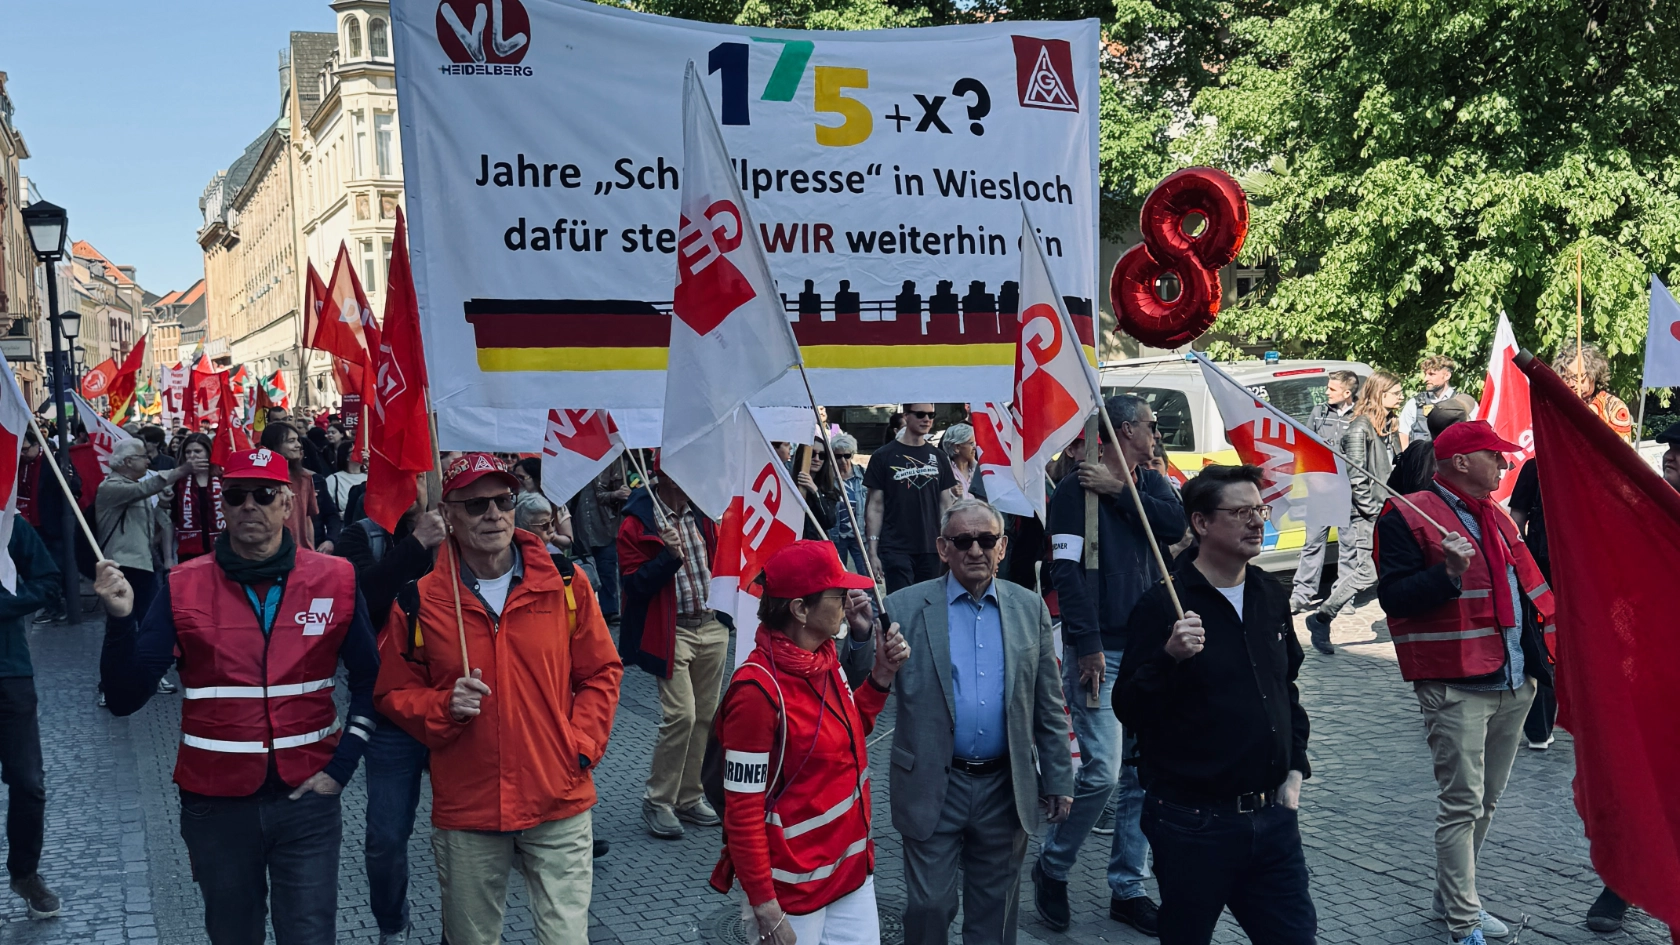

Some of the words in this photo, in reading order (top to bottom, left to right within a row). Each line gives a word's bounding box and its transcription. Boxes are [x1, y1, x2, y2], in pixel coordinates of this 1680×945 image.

[440, 64, 533, 77] HEIDELBERG
[707, 36, 873, 147] 175
[475, 153, 582, 188] Jahre
[593, 156, 882, 199] „Schlpresse“
[893, 165, 925, 197] in
[932, 167, 1074, 205] Wiesloch
[503, 217, 609, 252] dafür
[759, 222, 835, 254] WIR
[845, 223, 1007, 256] weiterhin
[248, 452, 273, 463] GEW
[294, 611, 334, 626] GEW
[724, 761, 768, 784] RDNER
